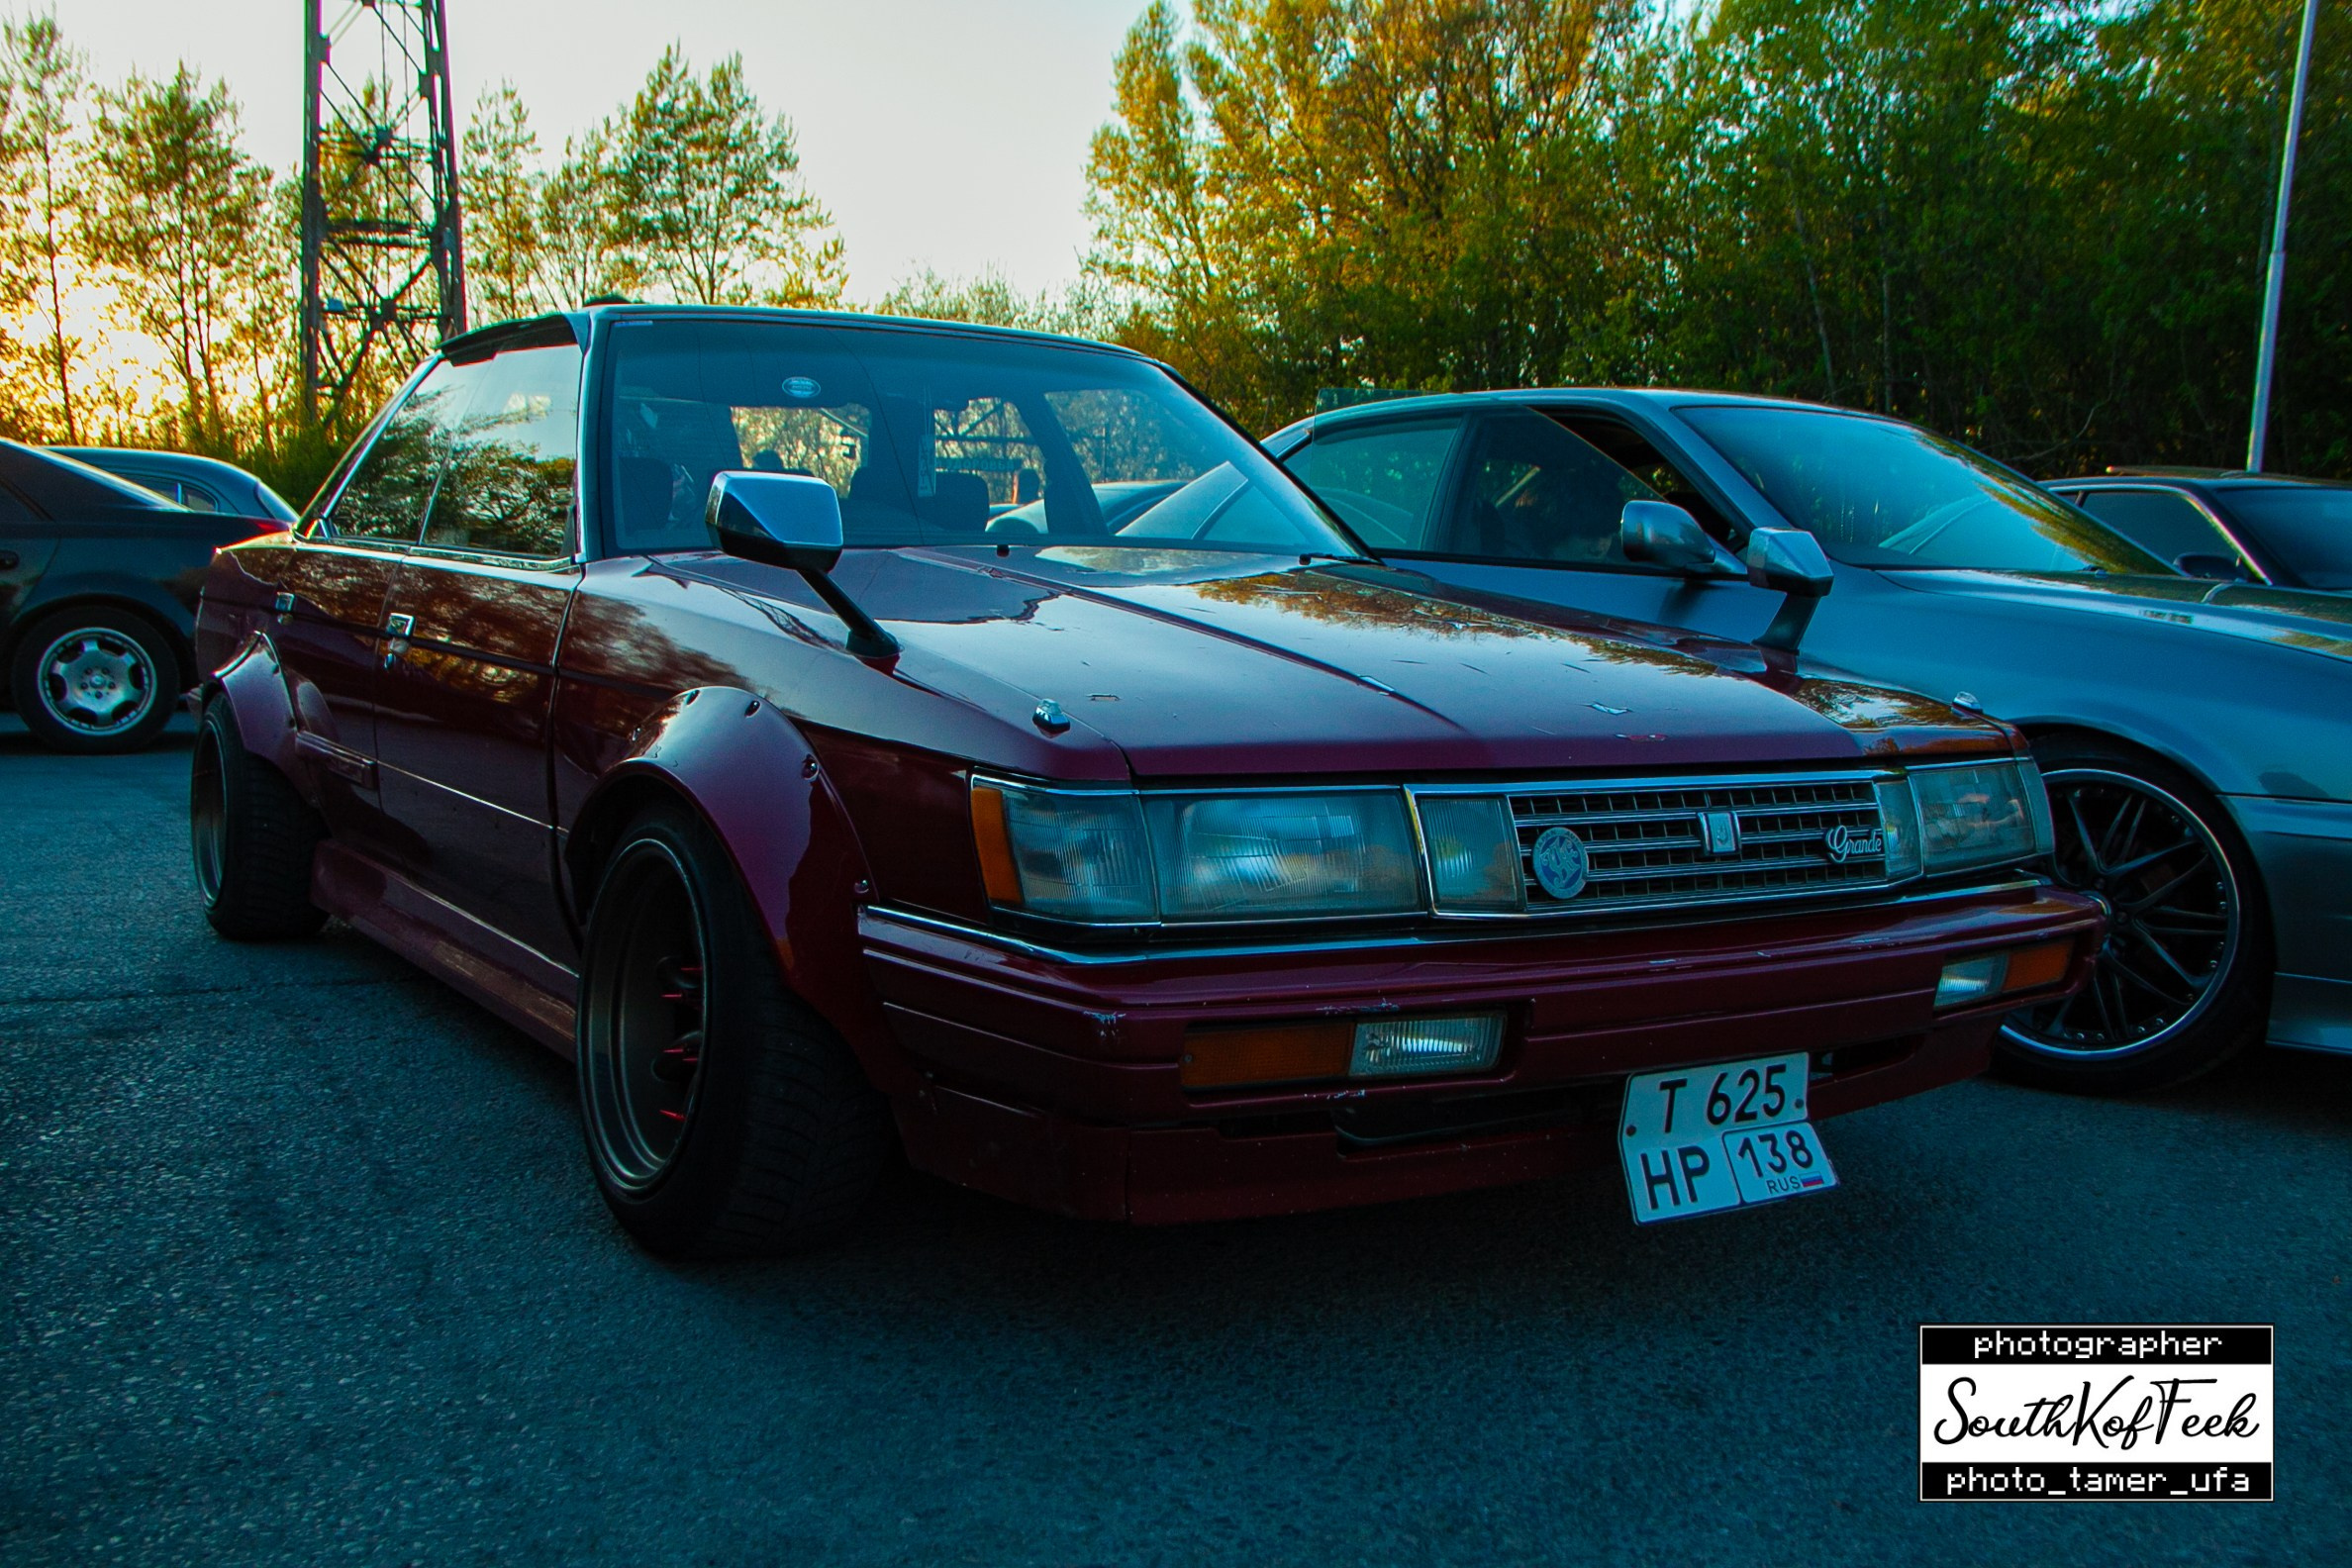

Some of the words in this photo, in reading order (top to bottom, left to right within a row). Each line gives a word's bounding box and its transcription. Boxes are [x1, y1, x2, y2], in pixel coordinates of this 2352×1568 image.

[1826, 825, 1882, 863] Grande
[1659, 1078, 1688, 1133] T
[1707, 1063, 1787, 1126] 625
[1640, 1145, 1711, 1210] HP
[1738, 1129, 1813, 1178] 138
[1766, 1175, 1801, 1195] RUS
